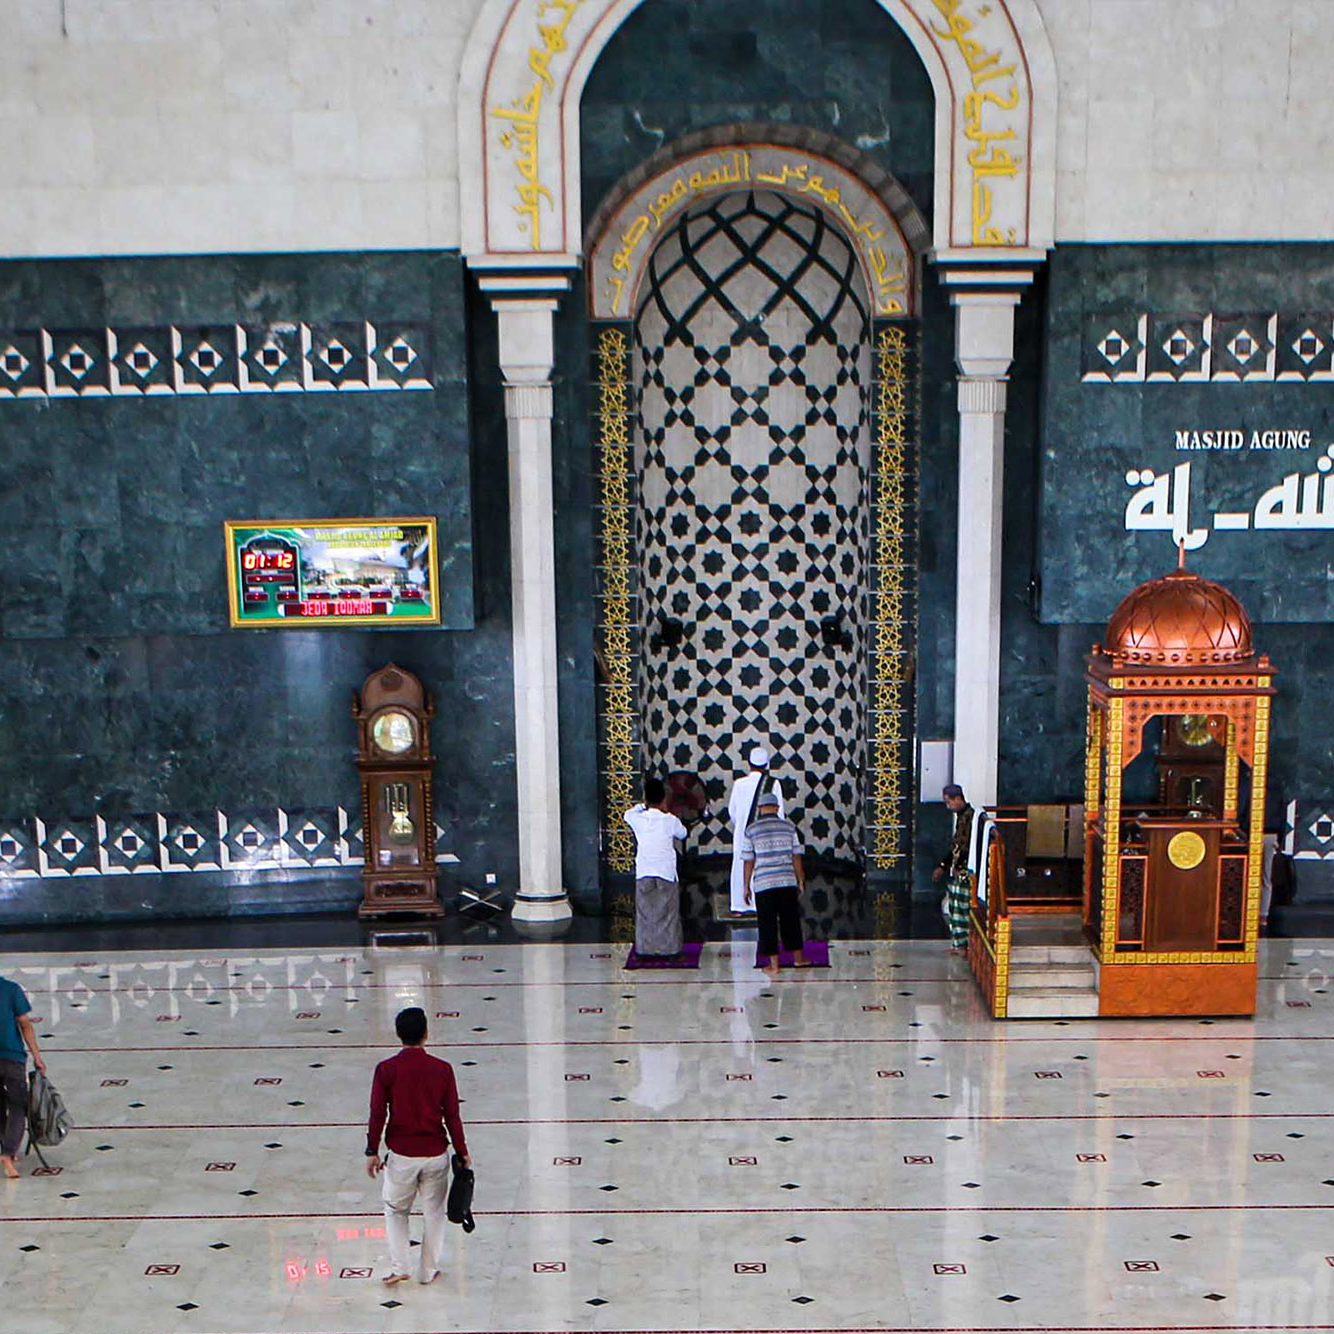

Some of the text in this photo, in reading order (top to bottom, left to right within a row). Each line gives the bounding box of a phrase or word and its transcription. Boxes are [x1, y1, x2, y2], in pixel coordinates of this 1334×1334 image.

[1175, 430, 1312, 450] MASJID AGUNG
[244, 552, 293, 569] 01:12
[300, 600, 328, 616] JEDA
